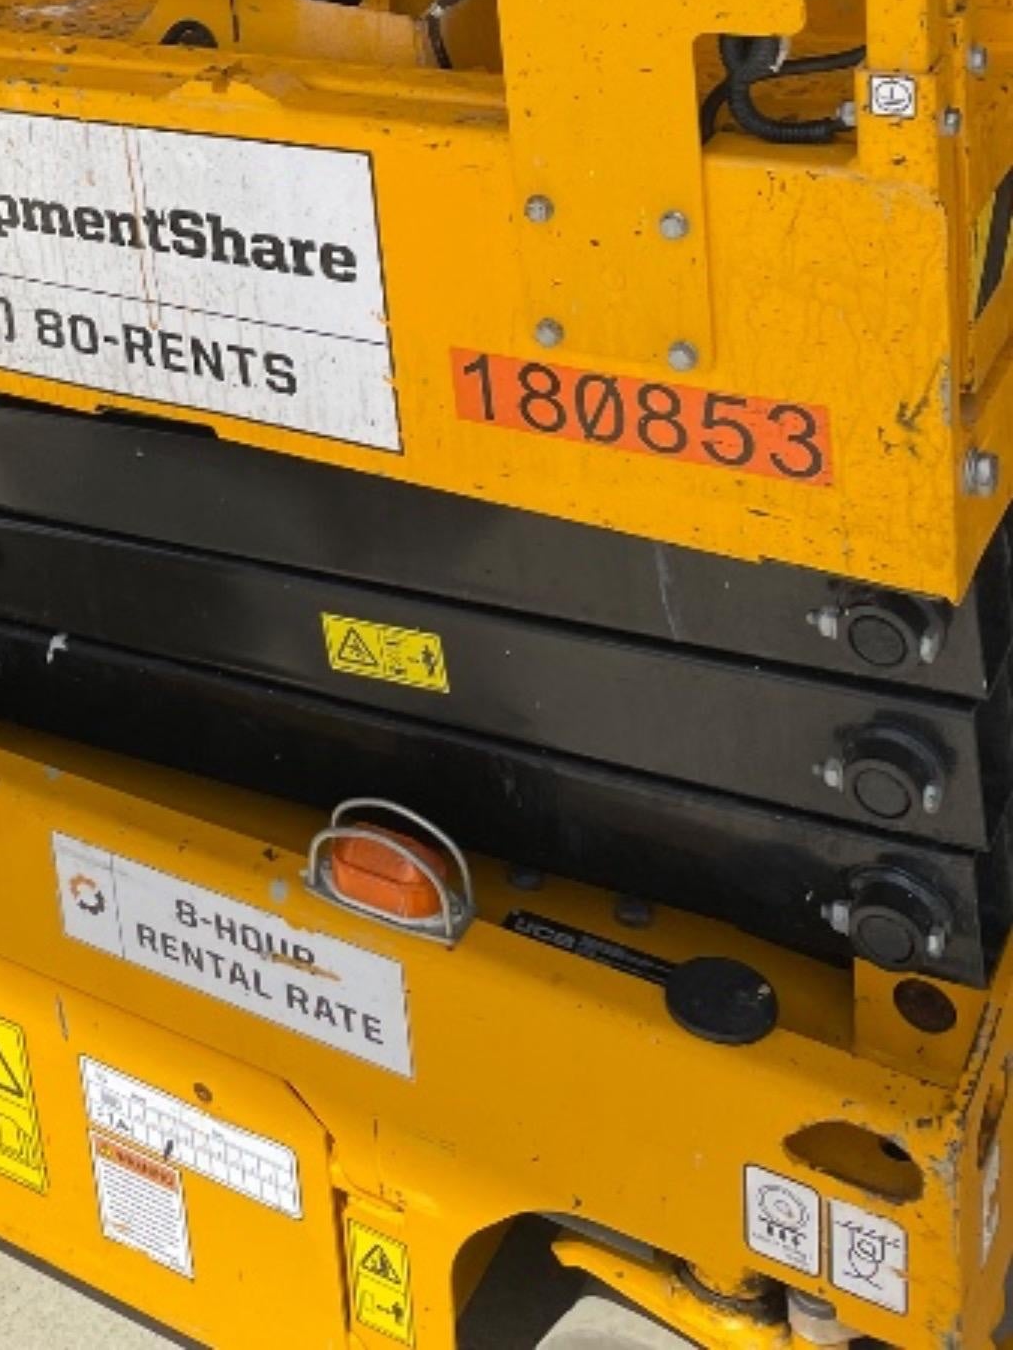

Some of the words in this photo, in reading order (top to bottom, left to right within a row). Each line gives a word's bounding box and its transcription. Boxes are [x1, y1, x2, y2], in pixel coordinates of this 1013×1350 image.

[36, 308, 298, 397] 80-RENTS
[463, 352, 824, 479] 180853
[136, 922, 273, 1000] RENTAL
[286, 983, 385, 1046] RATE
